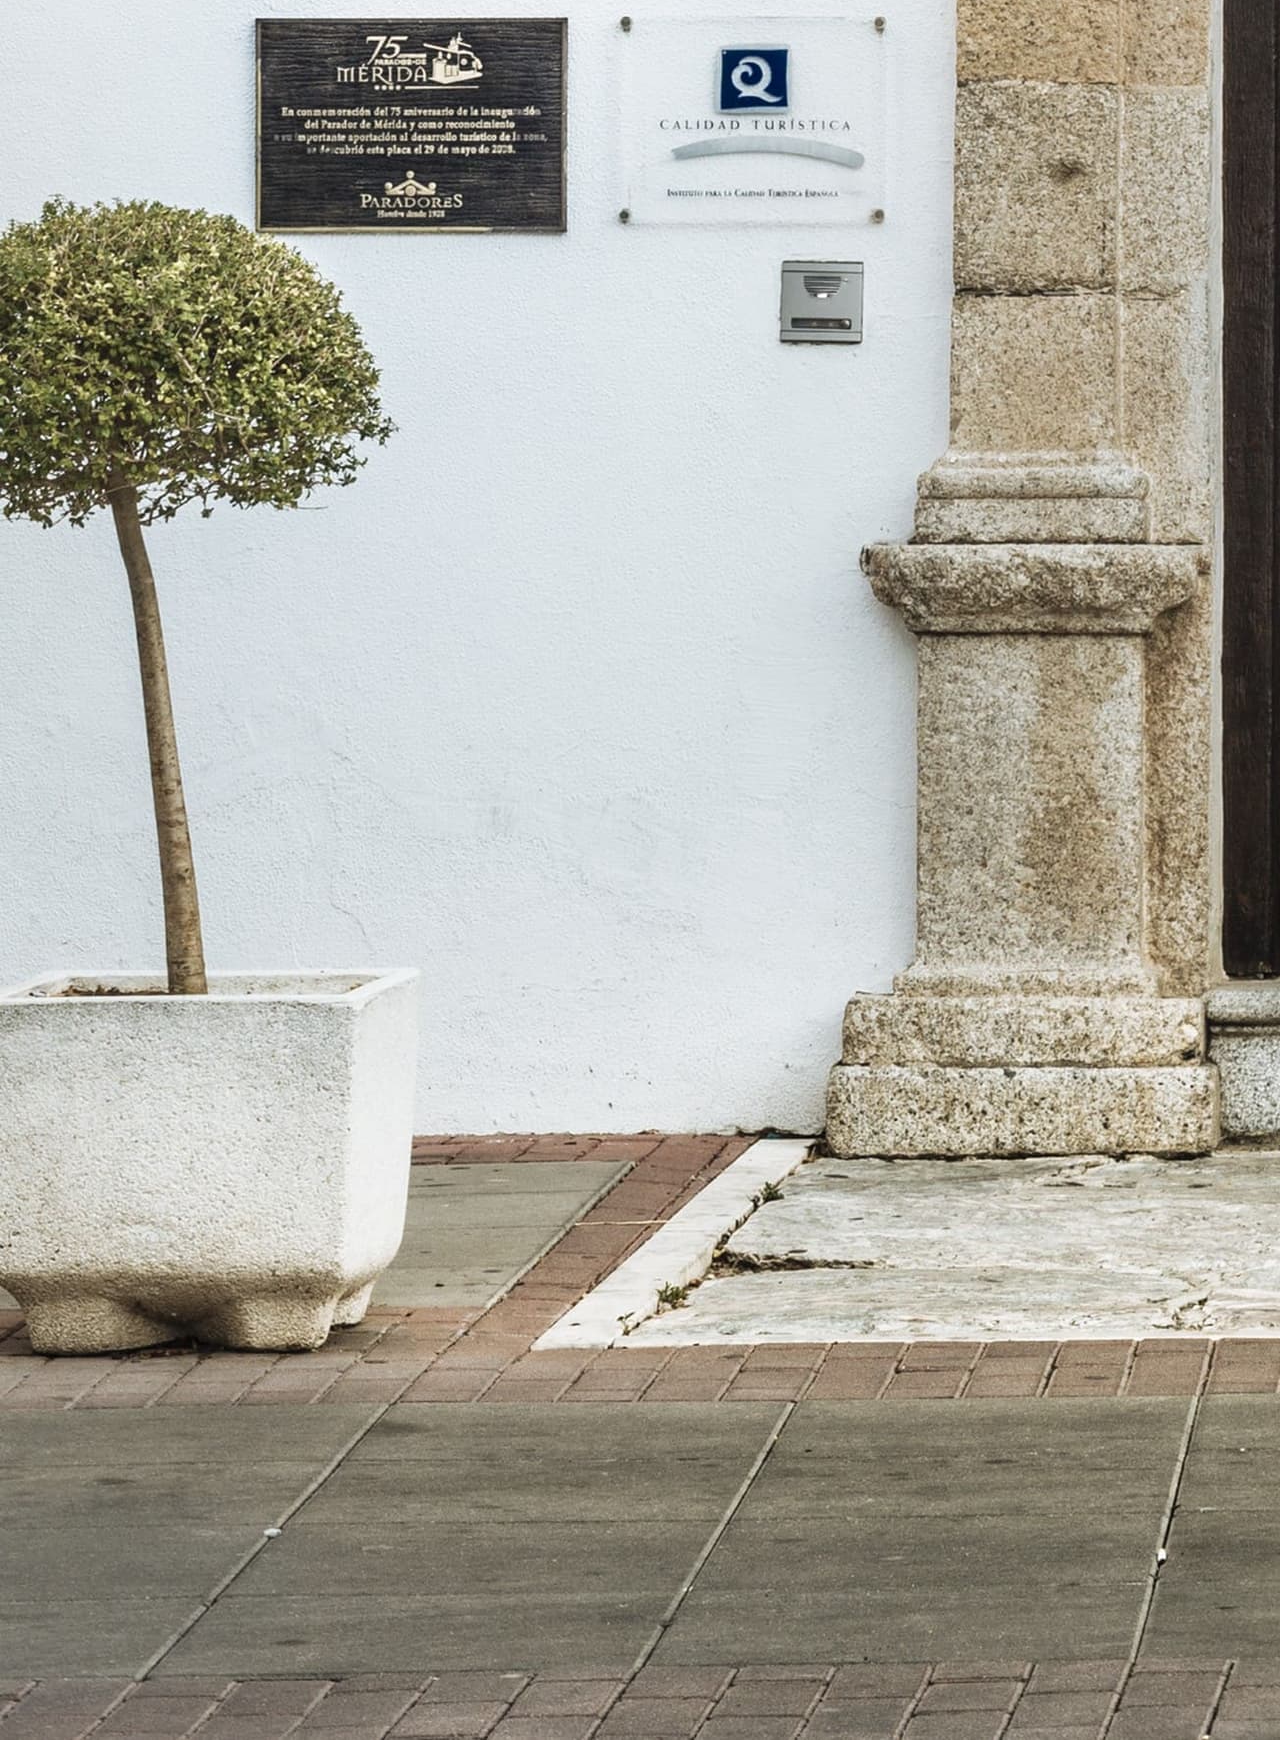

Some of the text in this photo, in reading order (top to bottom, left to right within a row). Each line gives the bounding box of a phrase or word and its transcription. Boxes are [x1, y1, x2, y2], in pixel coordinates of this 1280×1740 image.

[366, 35, 409, 66] 75
[336, 63, 428, 86] MÉRIDA
[730, 56, 784, 103] Q
[281, 107, 294, 116] En
[296, 106, 371, 117] conmemoración
[373, 106, 388, 117] del
[403, 107, 454, 117] aniversario
[456, 106, 467, 116] de
[470, 106, 479, 116] la
[304, 119, 516, 132] del Parador de Mérida y como reconocimiento
[659, 118, 851, 131] CALIDAD TURÍSTICA
[348, 131, 397, 144] aportación
[399, 132, 408, 142] al
[411, 131, 458, 142] desarrollo
[499, 131, 511, 142] de
[366, 145, 385, 155] esta
[387, 145, 412, 157] placa
[413, 144, 422, 154] el
[437, 144, 449, 154] de
[451, 147, 477, 157] mayo
[478, 144, 490, 155] de
[360, 193, 463, 208] PARADORES
